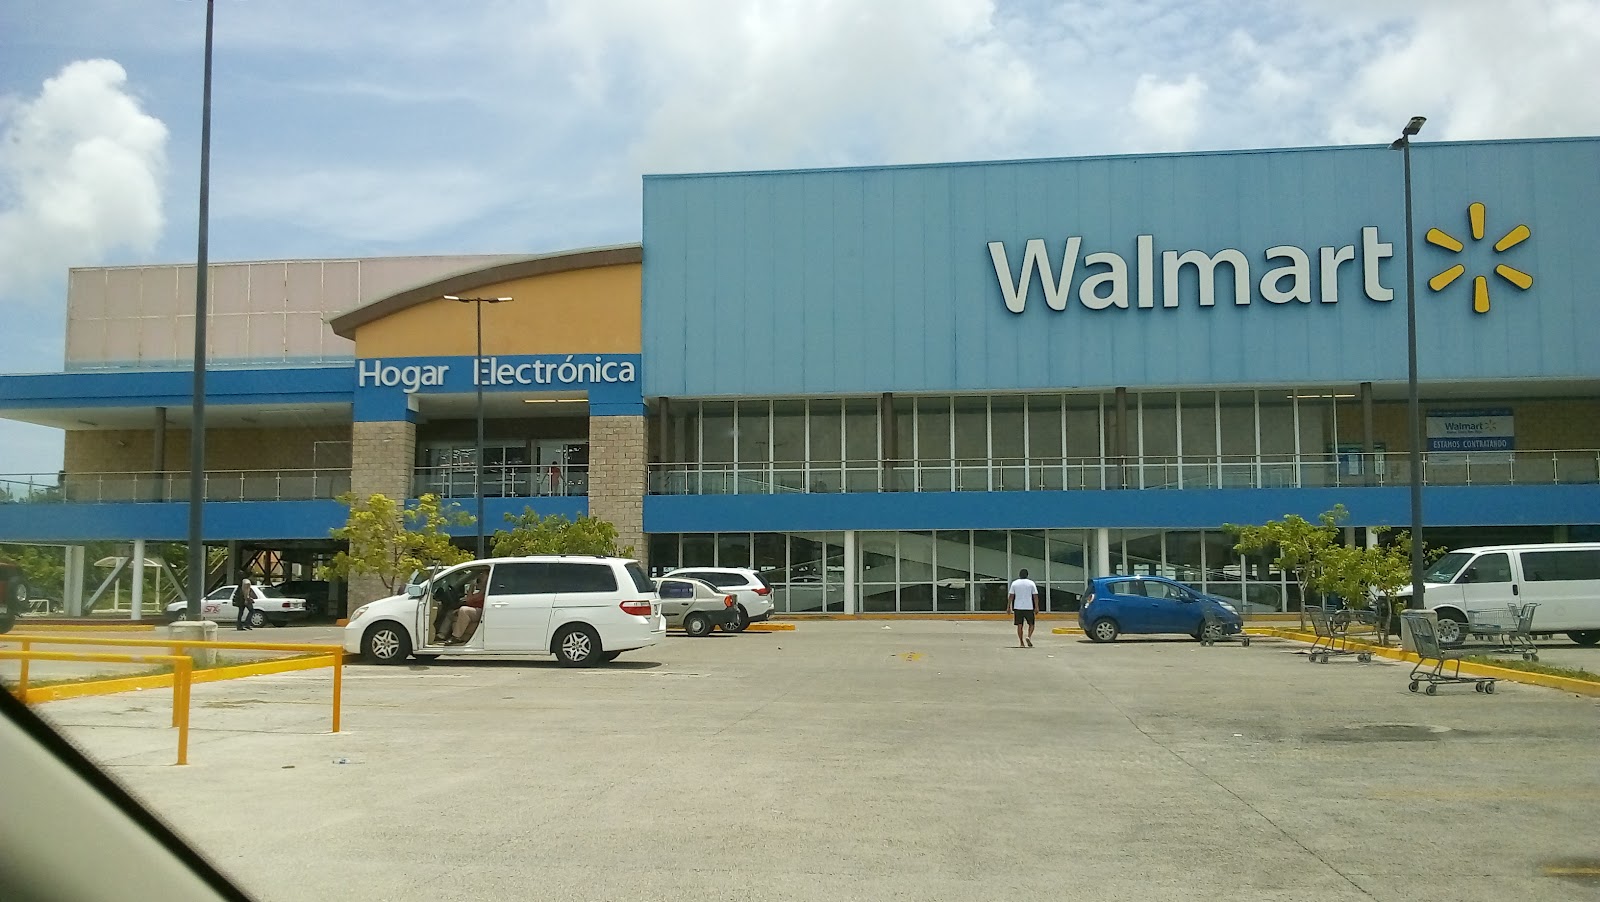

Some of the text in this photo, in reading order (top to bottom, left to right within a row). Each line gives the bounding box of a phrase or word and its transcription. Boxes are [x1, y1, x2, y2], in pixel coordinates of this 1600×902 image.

[986, 225, 1395, 314] Walmart
[358, 354, 636, 394] Hogar Electrónica
[1445, 422, 1483, 431] Walmart
[1433, 439, 1507, 449] ESTAMOS CONTRATANDO
